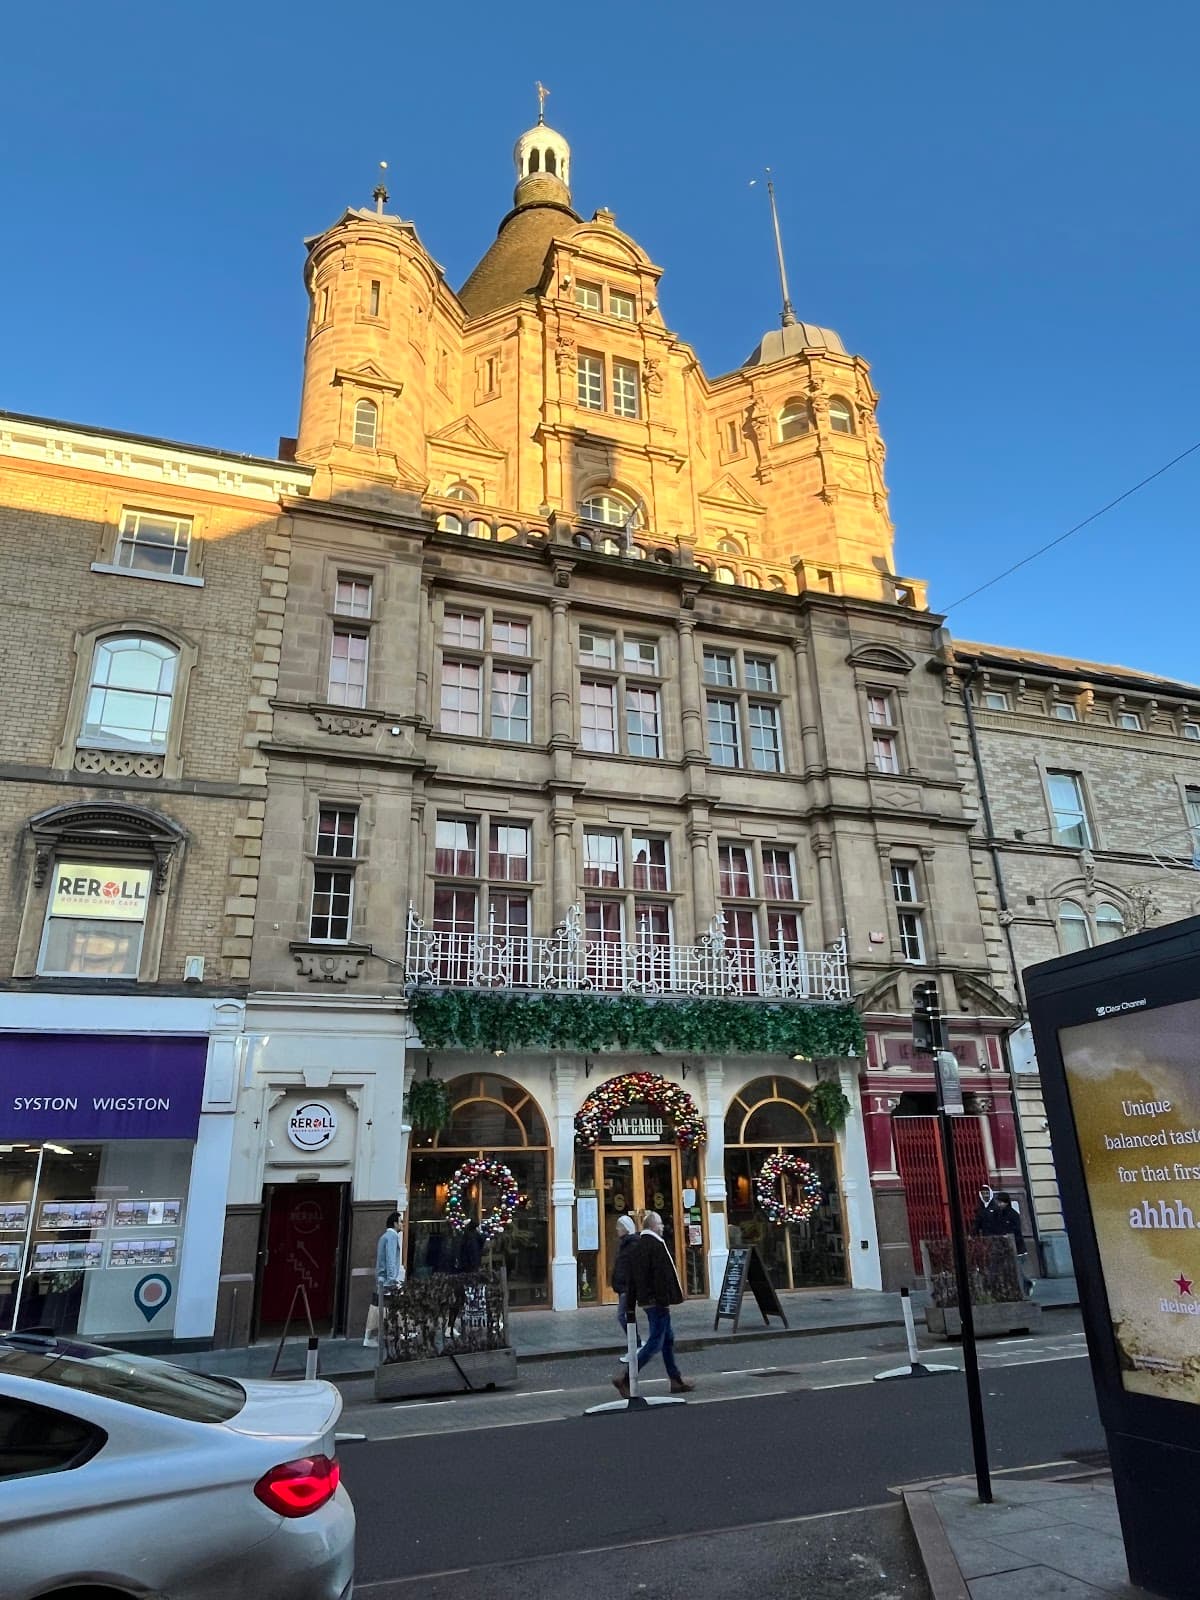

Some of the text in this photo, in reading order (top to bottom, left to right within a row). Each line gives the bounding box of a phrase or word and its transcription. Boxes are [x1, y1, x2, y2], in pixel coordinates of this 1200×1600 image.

[58, 876, 145, 899] REROLL
[1121, 997, 1147, 1009] Channel
[13, 1097, 170, 1111] SYSTON WIGSTON
[1121, 1099, 1172, 1118] Unique
[291, 1117, 335, 1129] REROLL
[608, 1117, 663, 1135] SAN CARLO
[1104, 1127, 1200, 1150] balanced tast
[1118, 1166, 1138, 1183] for
[1141, 1164, 1171, 1182] that
